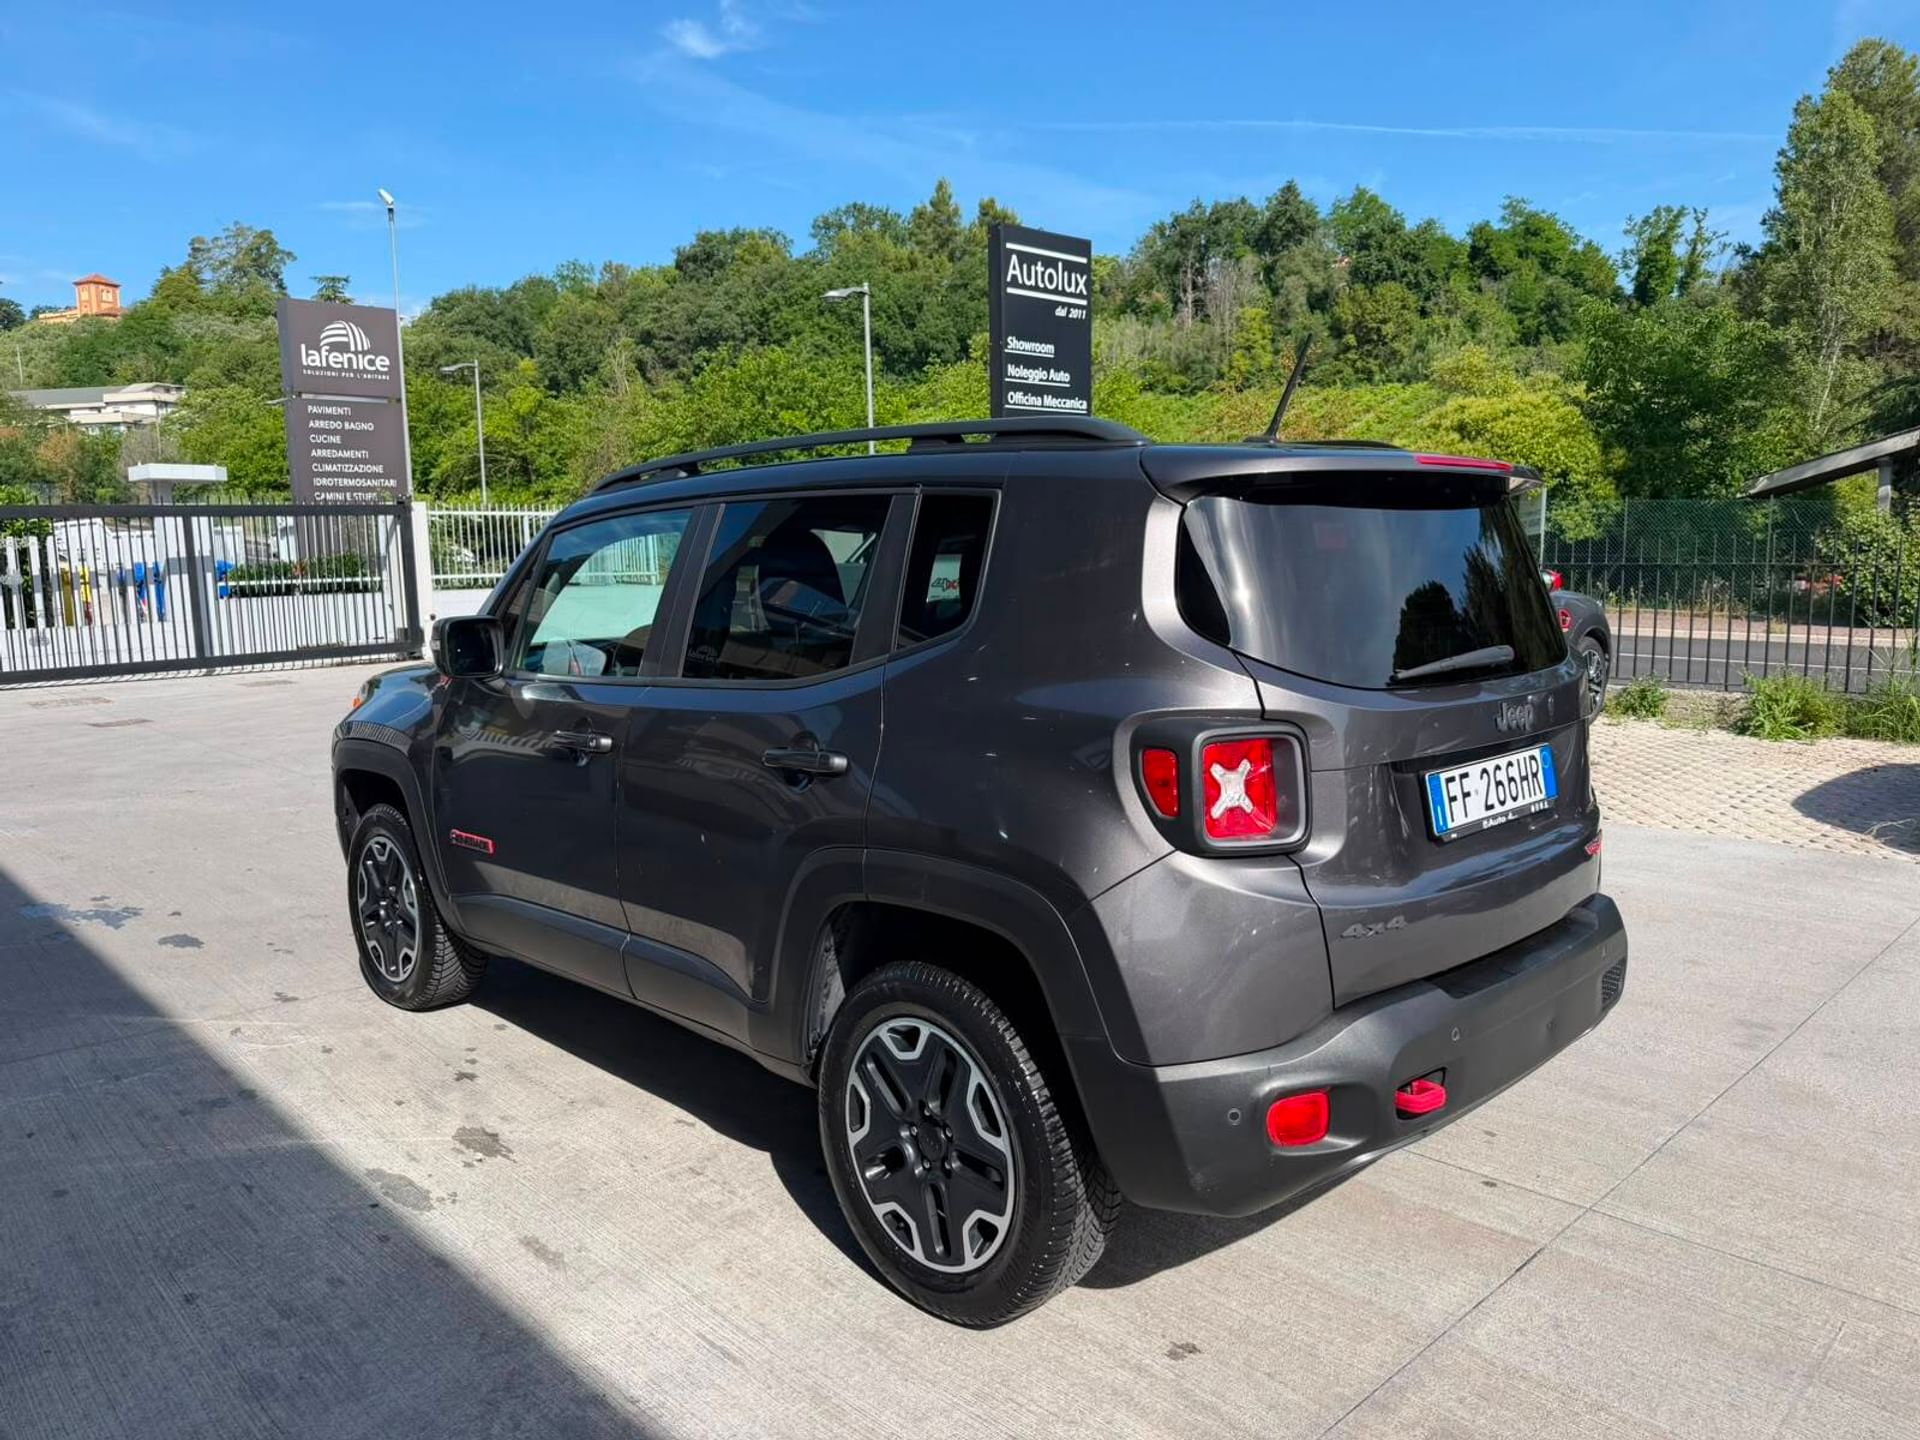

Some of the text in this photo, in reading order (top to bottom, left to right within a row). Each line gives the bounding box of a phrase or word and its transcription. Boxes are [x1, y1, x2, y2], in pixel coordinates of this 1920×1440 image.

[1006, 254, 1087, 296] Autolux
[1055, 305, 1087, 320] dal 2011
[1006, 336, 1055, 354] Showroom
[301, 343, 390, 372] lafenice
[1007, 364, 1071, 383] Noleggio Auto
[1007, 391, 1088, 410] Officina Meccanica
[308, 405, 351, 416] PAVIMENTI
[309, 420, 375, 432] ARREDO BAGNO
[310, 434, 342, 444] CUCINE
[311, 449, 369, 460] ARREDAMENTI
[312, 463, 384, 474] CLIMATIZZAZIONE
[313, 478, 397, 488] IDROTERMOSANITARI
[1495, 702, 1534, 732] Jeep
